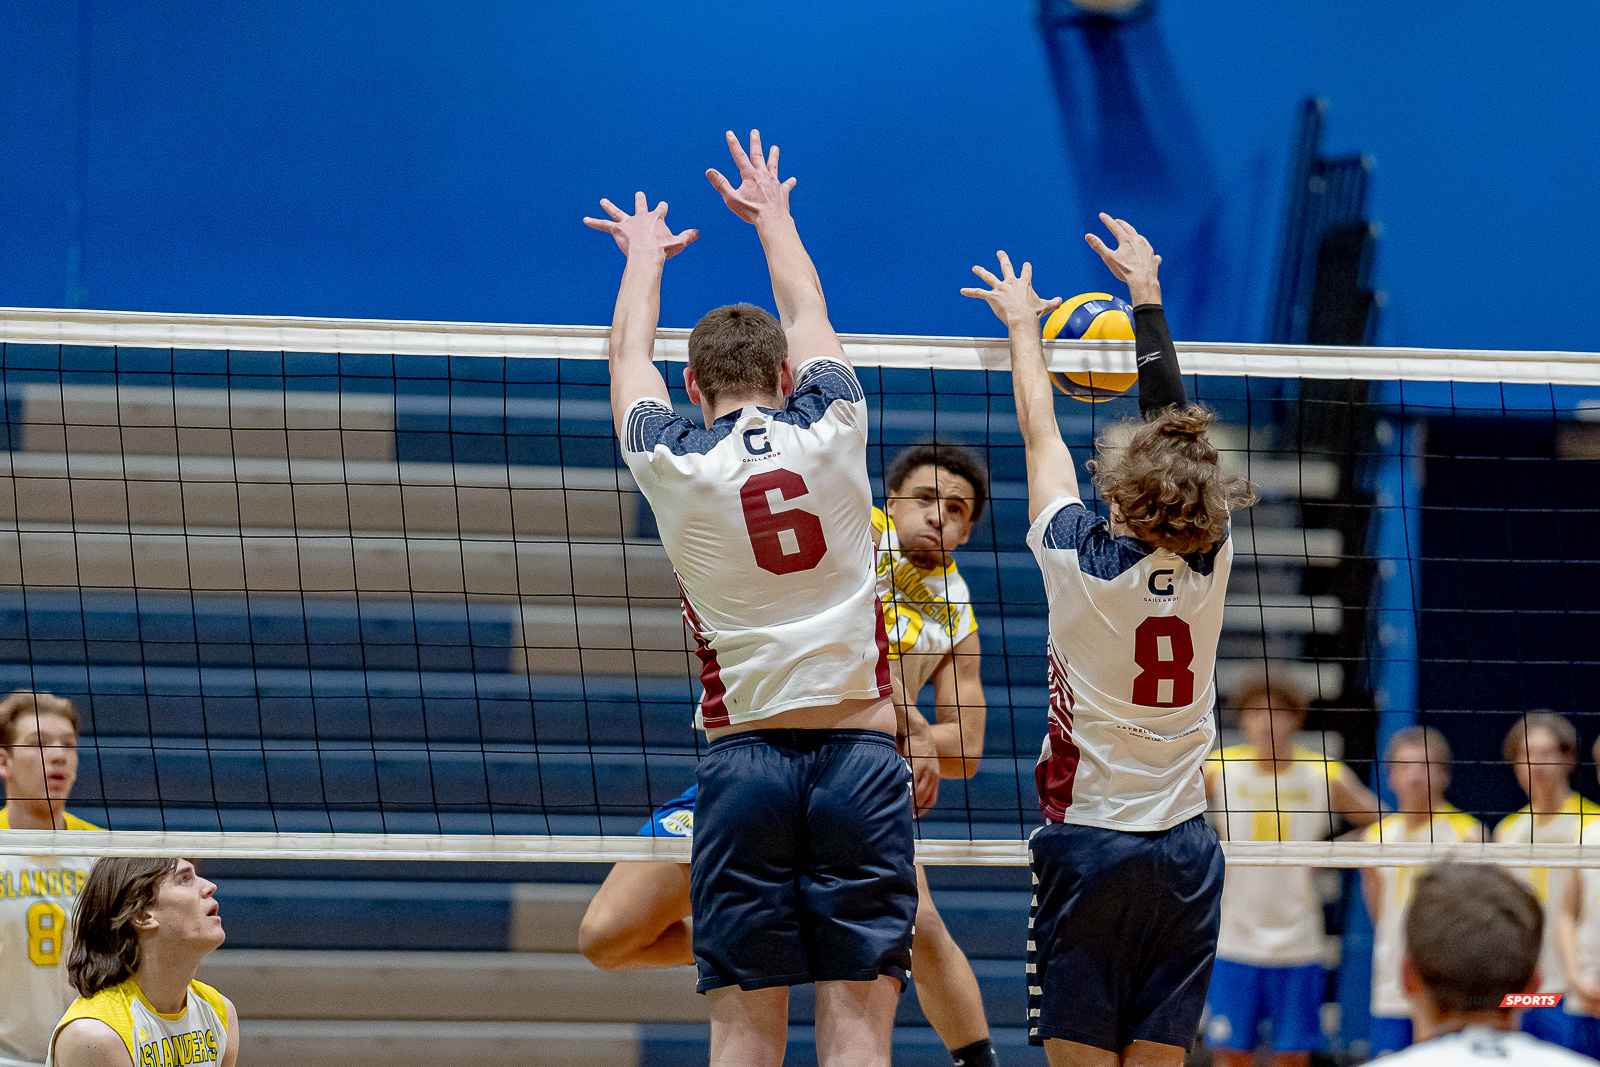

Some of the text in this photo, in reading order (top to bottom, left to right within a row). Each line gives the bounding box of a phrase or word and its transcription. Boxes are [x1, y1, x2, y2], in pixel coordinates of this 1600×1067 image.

[742, 451, 781, 463] GAILLARDS
[743, 427, 772, 455] G
[740, 467, 828, 575] 6
[1148, 568, 1175, 596] G
[1132, 615, 1195, 708] 8
[27, 901, 66, 968] 8
[140, 1029, 217, 1067] ISLANDERS
